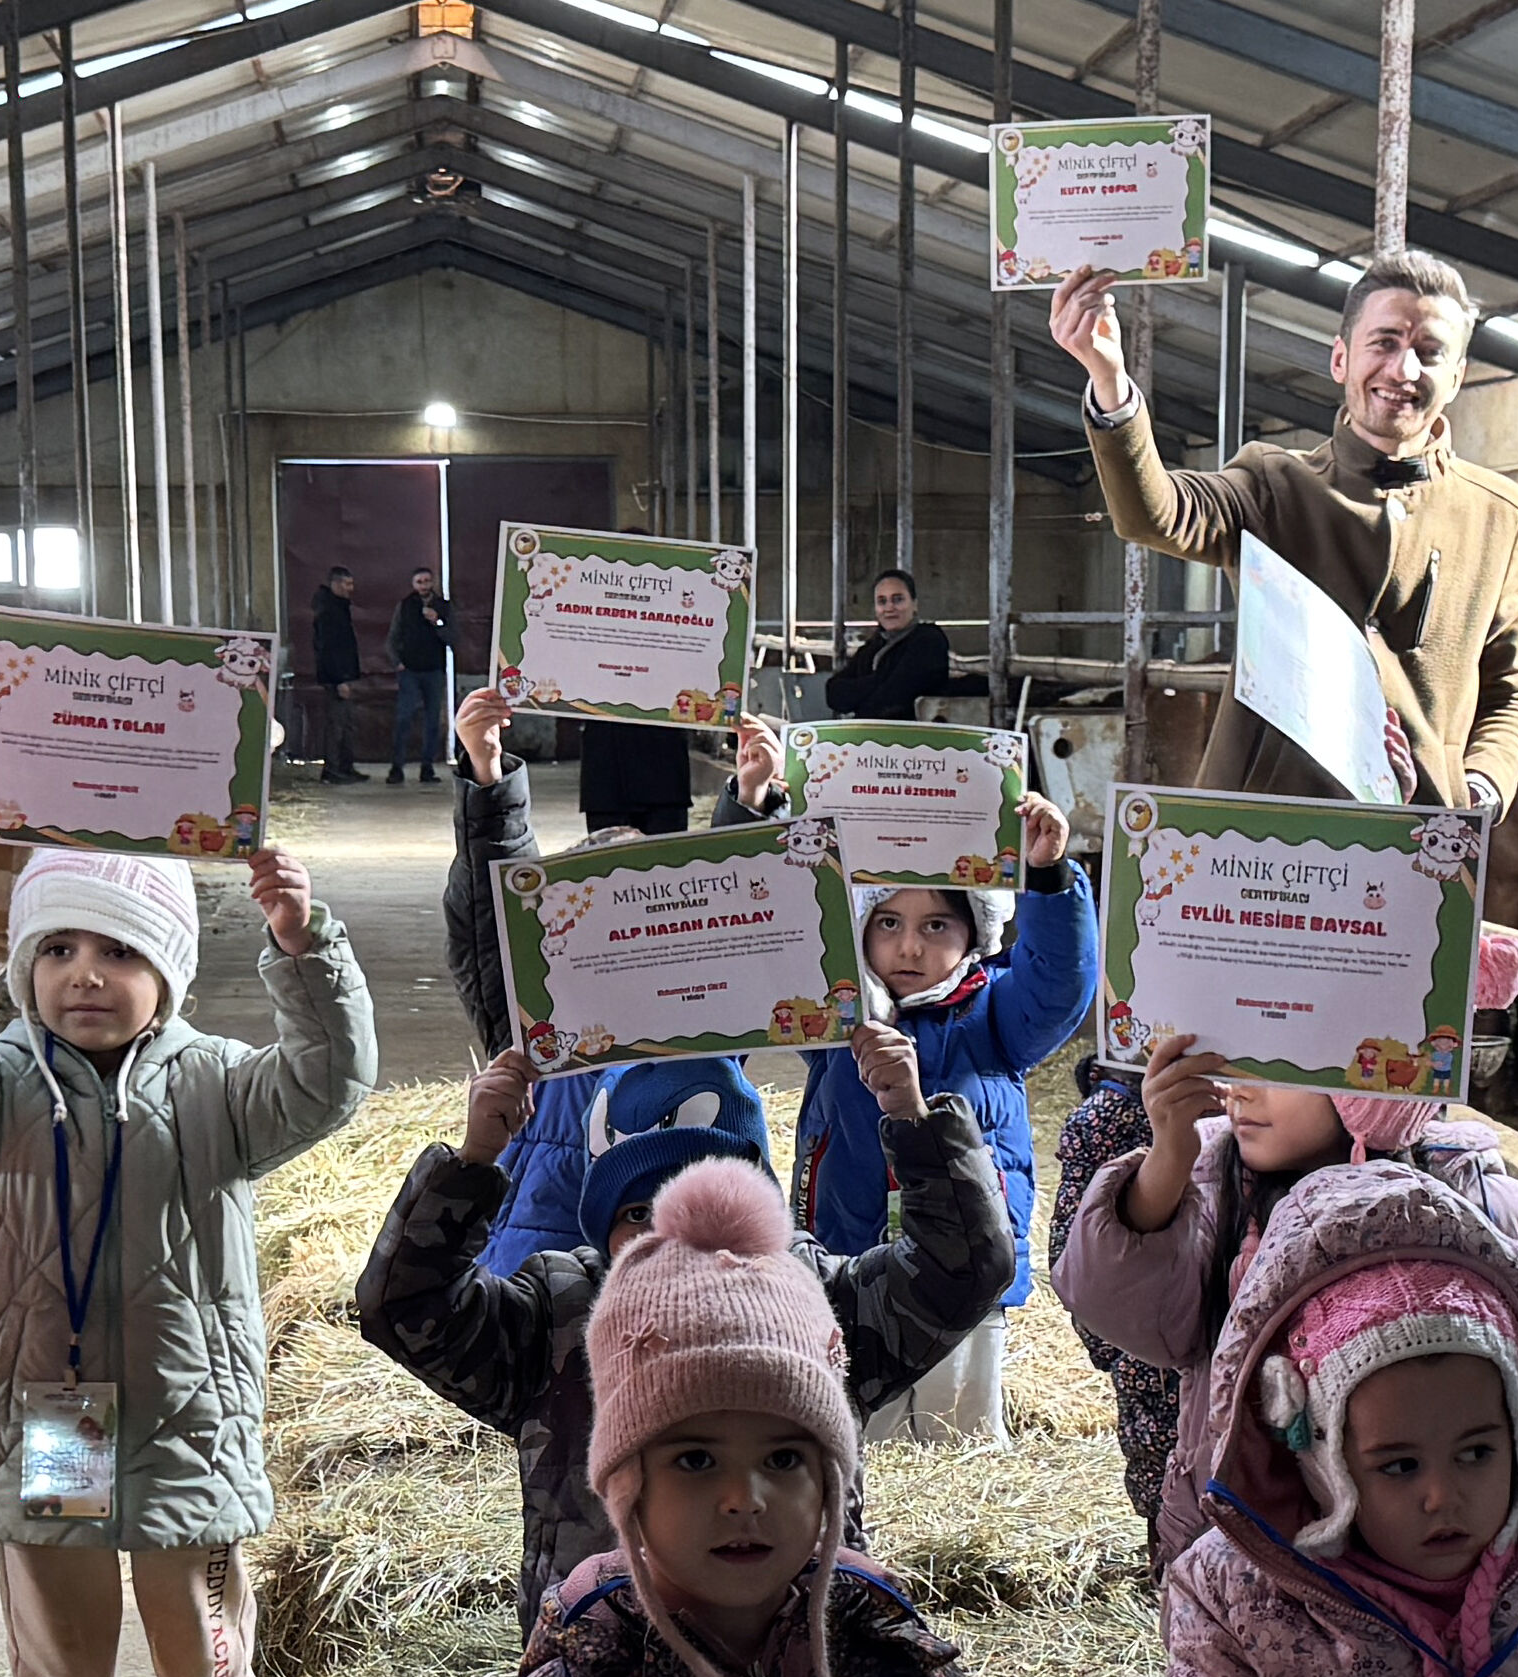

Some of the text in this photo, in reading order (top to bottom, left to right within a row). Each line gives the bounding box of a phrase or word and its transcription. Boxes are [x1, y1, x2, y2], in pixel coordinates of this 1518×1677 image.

[580, 568, 673, 595] MİNİK ÇİFTÇİ
[44, 666, 165, 698] MİNİK ÇİFTÇİ
[53, 711, 108, 730] ZÜMRA
[856, 755, 946, 774] MİNİK ÇİFTÇİ
[613, 871, 739, 905] MİNİK ÇİFTÇİ
[1210, 854, 1348, 891] MİNİK ÇİFTÇİ
[609, 910, 774, 942] ALP HASAN ATALAY
[1181, 904, 1388, 937] EYLÜL NESİBE BAYSAL
